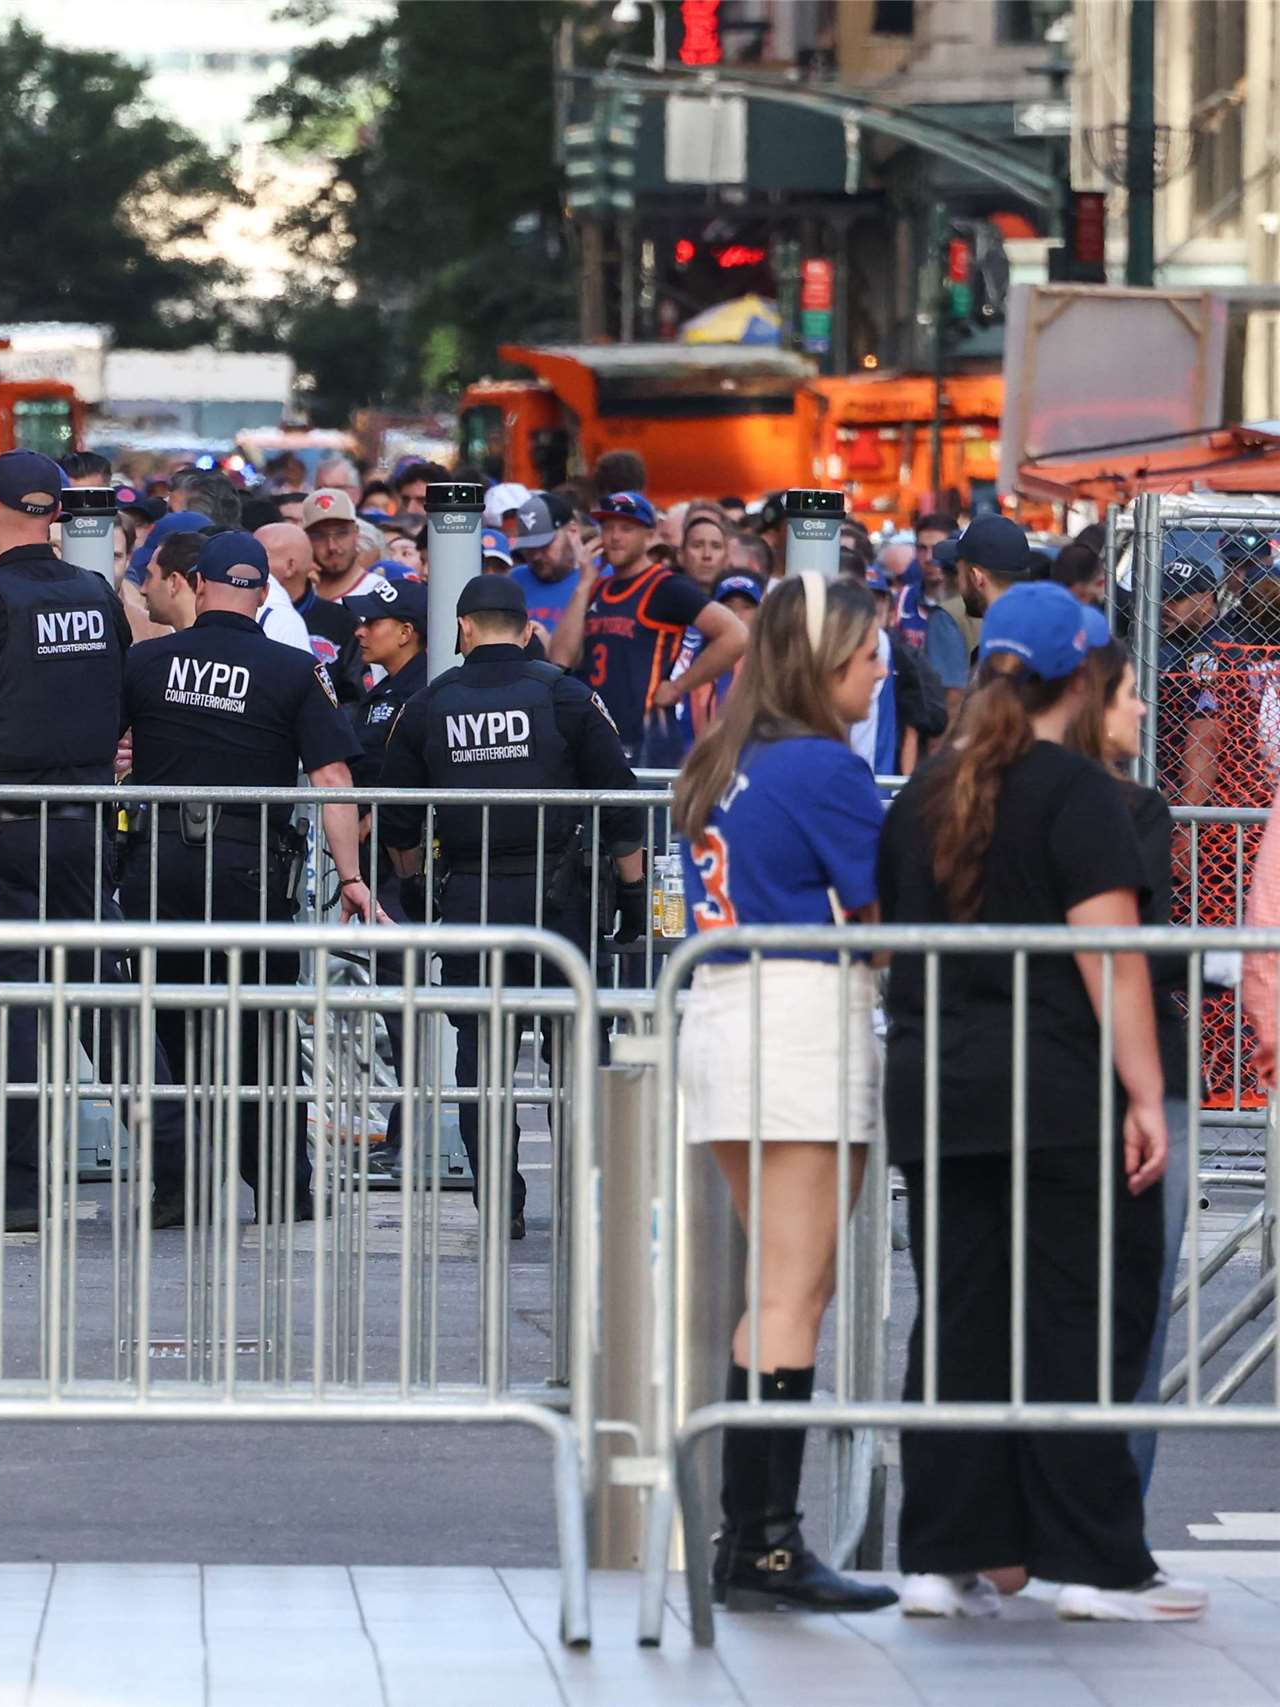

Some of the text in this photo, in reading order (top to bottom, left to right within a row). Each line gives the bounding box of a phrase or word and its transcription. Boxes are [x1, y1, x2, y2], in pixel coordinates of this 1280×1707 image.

[37, 610, 104, 643] NYPD
[37, 642, 107, 654] COUNTERTERRORISM
[167, 656, 250, 699] NYPD
[591, 643, 608, 687] 3
[164, 688, 246, 714] COUNTERTERRORISM
[446, 710, 530, 748] NYPD
[451, 744, 529, 762] COUNTERTERRORISM
